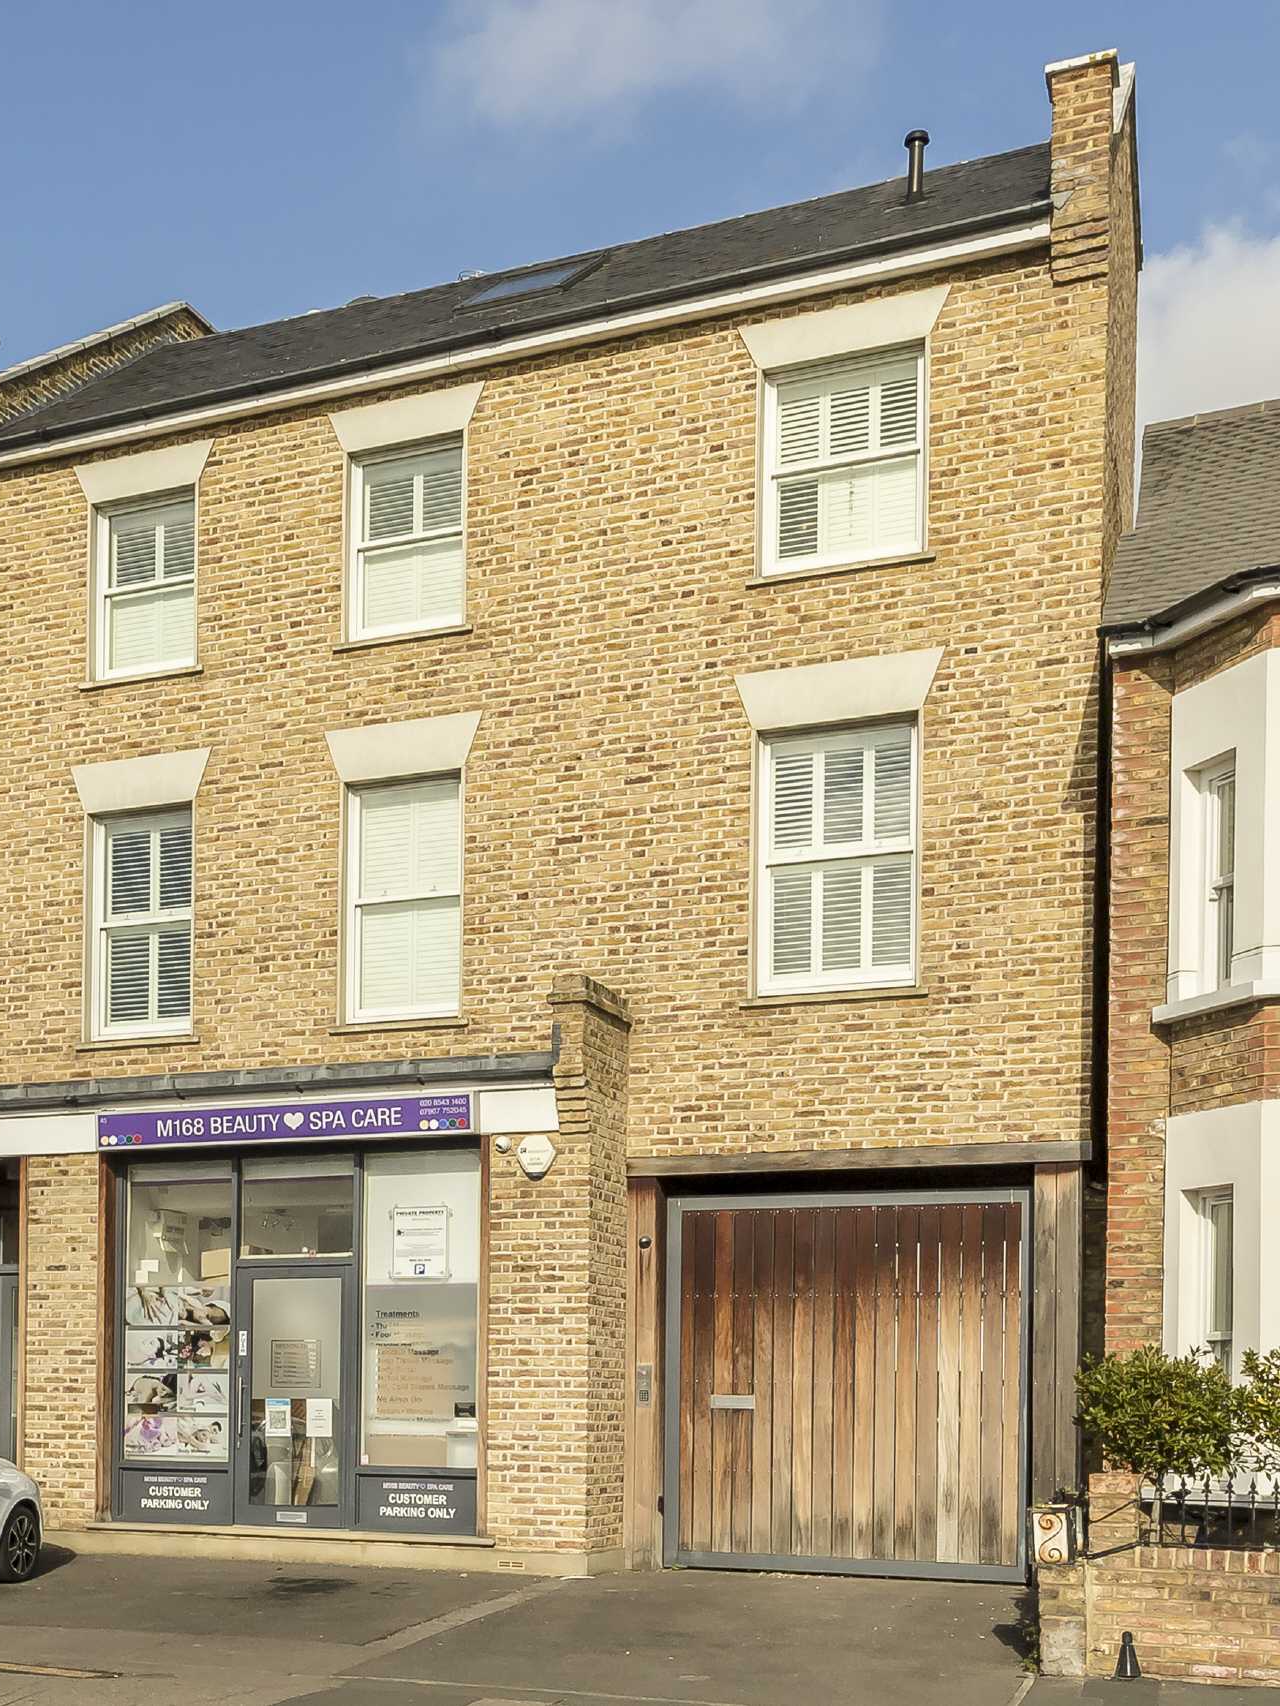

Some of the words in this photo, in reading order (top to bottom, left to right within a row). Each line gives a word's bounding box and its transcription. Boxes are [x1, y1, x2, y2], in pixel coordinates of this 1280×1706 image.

[156, 1117, 205, 1138] M168
[210, 1113, 280, 1135] BEAUTY
[309, 1109, 346, 1130] SPA
[351, 1106, 403, 1128] CARE
[375, 1310, 421, 1319] Treatments
[148, 1486, 202, 1497] CUSTOMER
[141, 1498, 183, 1509] PARKING
[184, 1499, 210, 1510] ONLY
[388, 1493, 447, 1505] CUSTOMER
[379, 1506, 426, 1517] PARKING
[427, 1507, 457, 1518] ONLY
